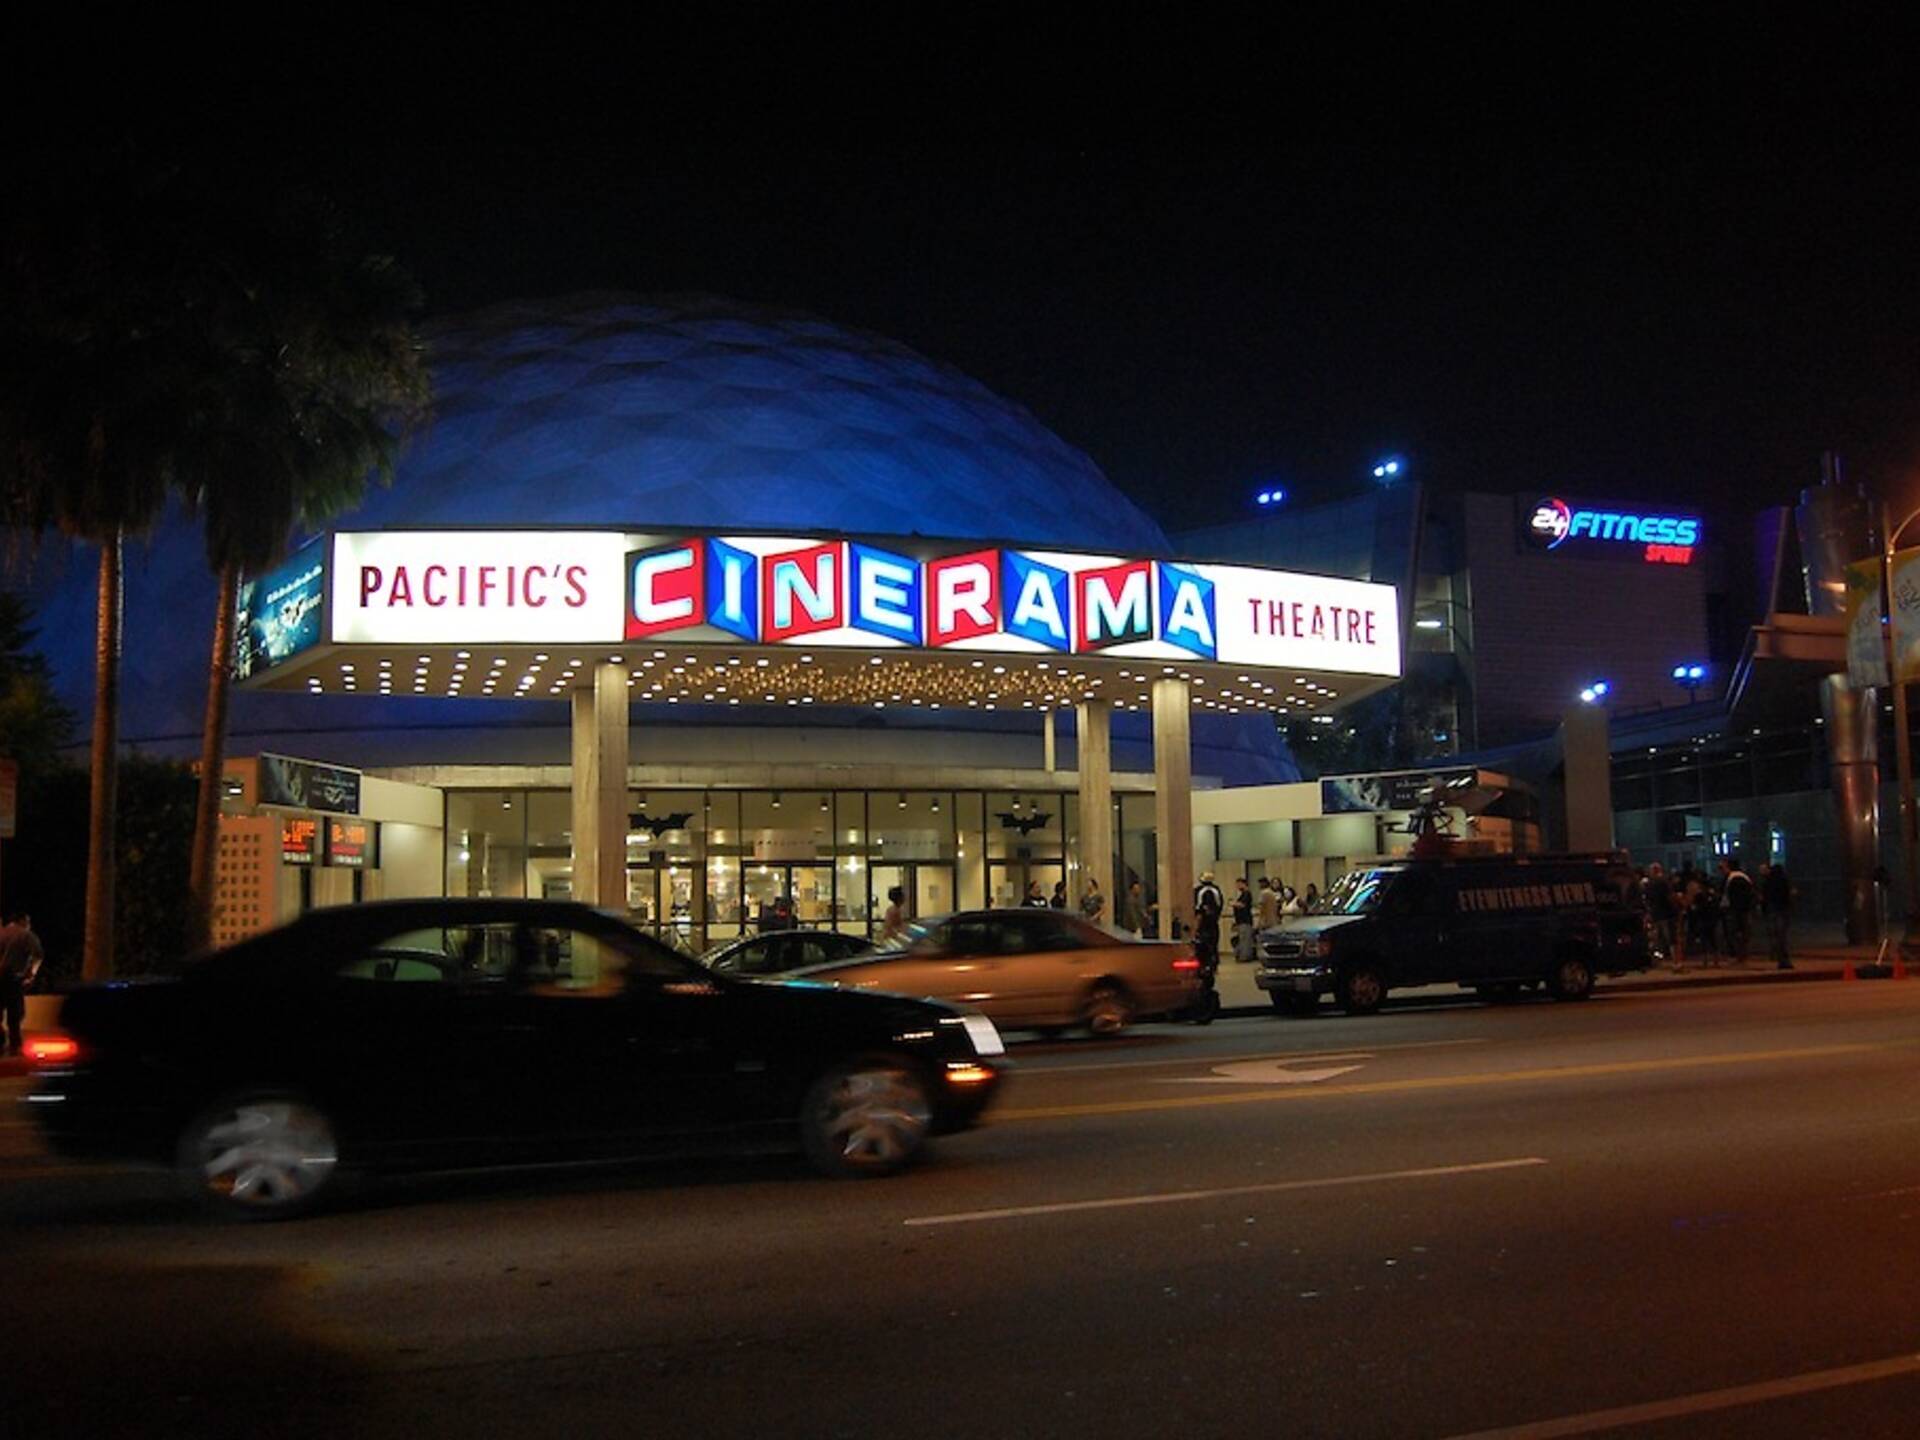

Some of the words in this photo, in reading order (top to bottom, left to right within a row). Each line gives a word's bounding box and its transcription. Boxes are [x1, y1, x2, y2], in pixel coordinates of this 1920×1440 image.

[1568, 511, 1697, 545] FITNESS
[359, 564, 589, 608] PACIFIC'S
[632, 547, 1215, 647] CINERAMA
[1248, 598, 1376, 645] THEATRE
